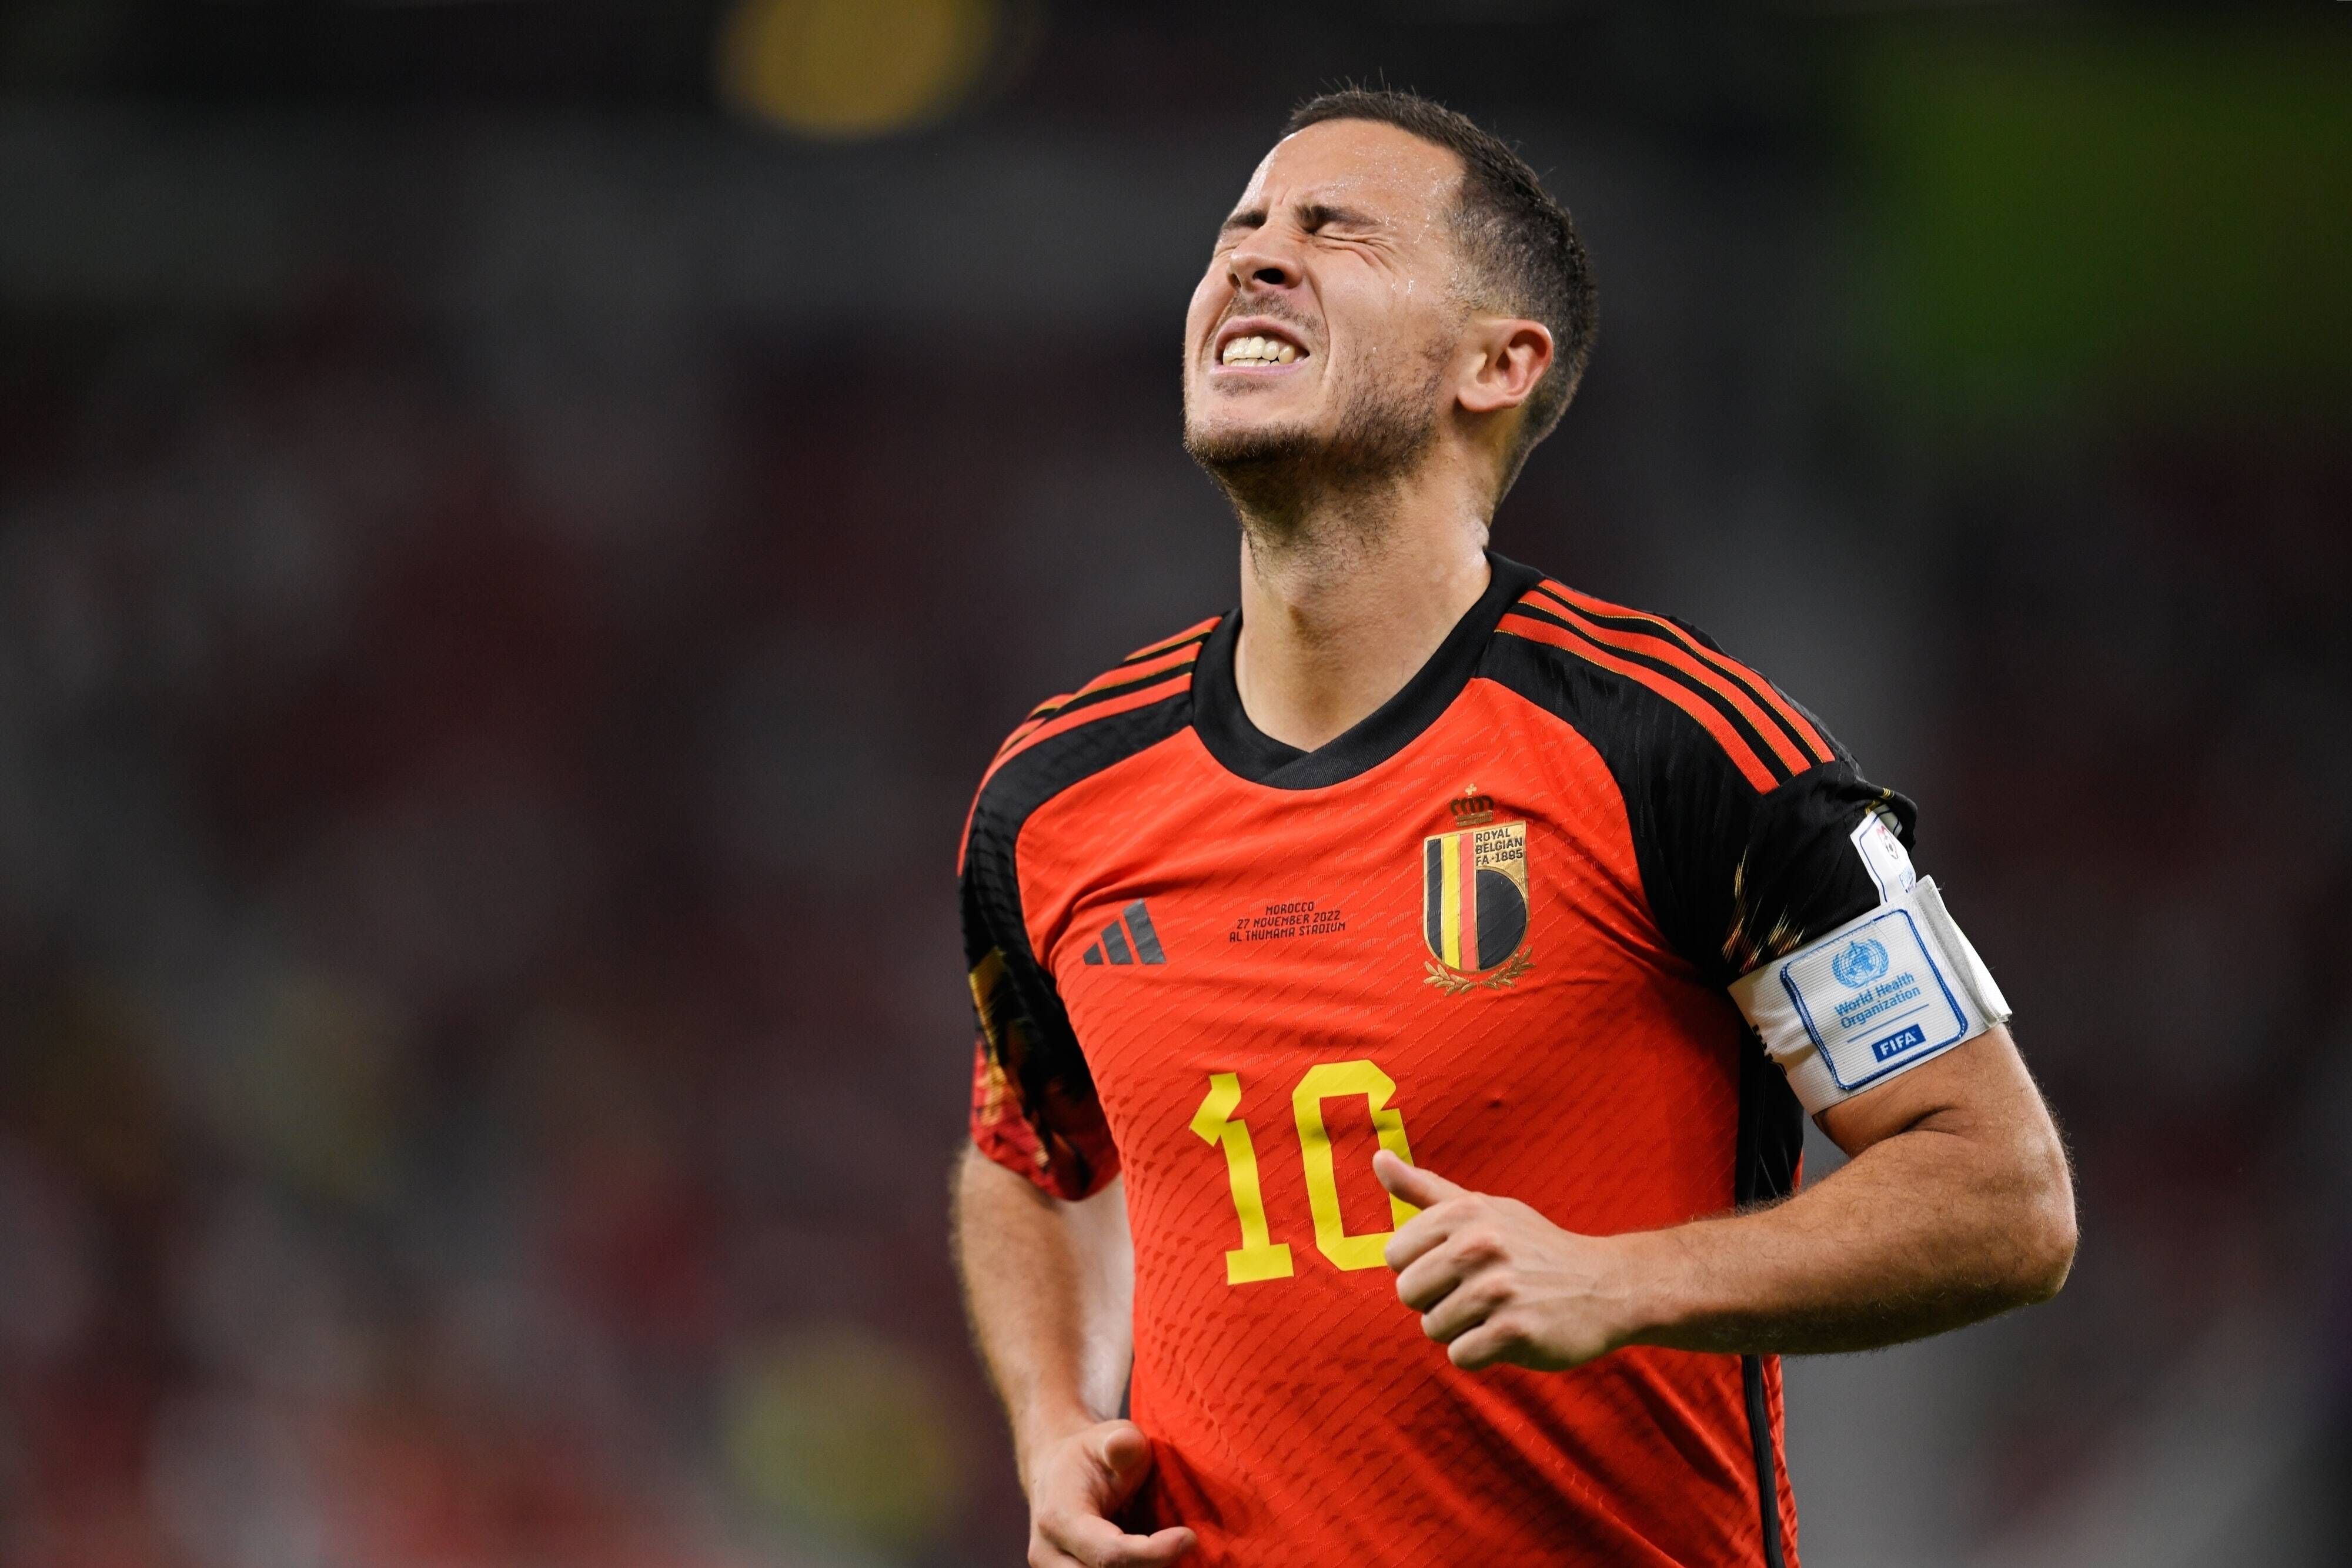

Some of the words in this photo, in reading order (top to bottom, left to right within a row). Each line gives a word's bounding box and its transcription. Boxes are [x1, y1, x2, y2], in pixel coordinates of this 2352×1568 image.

[1476, 828, 1510, 842] ROYAL
[1476, 837, 1522, 854] BELGIAN
[1265, 901, 1314, 915] MOROCCO
[1237, 918, 1250, 930] 27
[1253, 914, 1309, 928] NOVEMBER
[1313, 910, 1341, 923] 2022
[1230, 931, 1242, 942] AL
[1245, 927, 1295, 941] THUMAMA
[1299, 921, 1345, 937] STADIUM
[1835, 989, 1873, 1016] World
[1875, 972, 1915, 997] Health
[1840, 987, 1921, 1028] Organization
[1879, 1032, 1917, 1056] FIFA
[1188, 1059, 1422, 1286] 10
